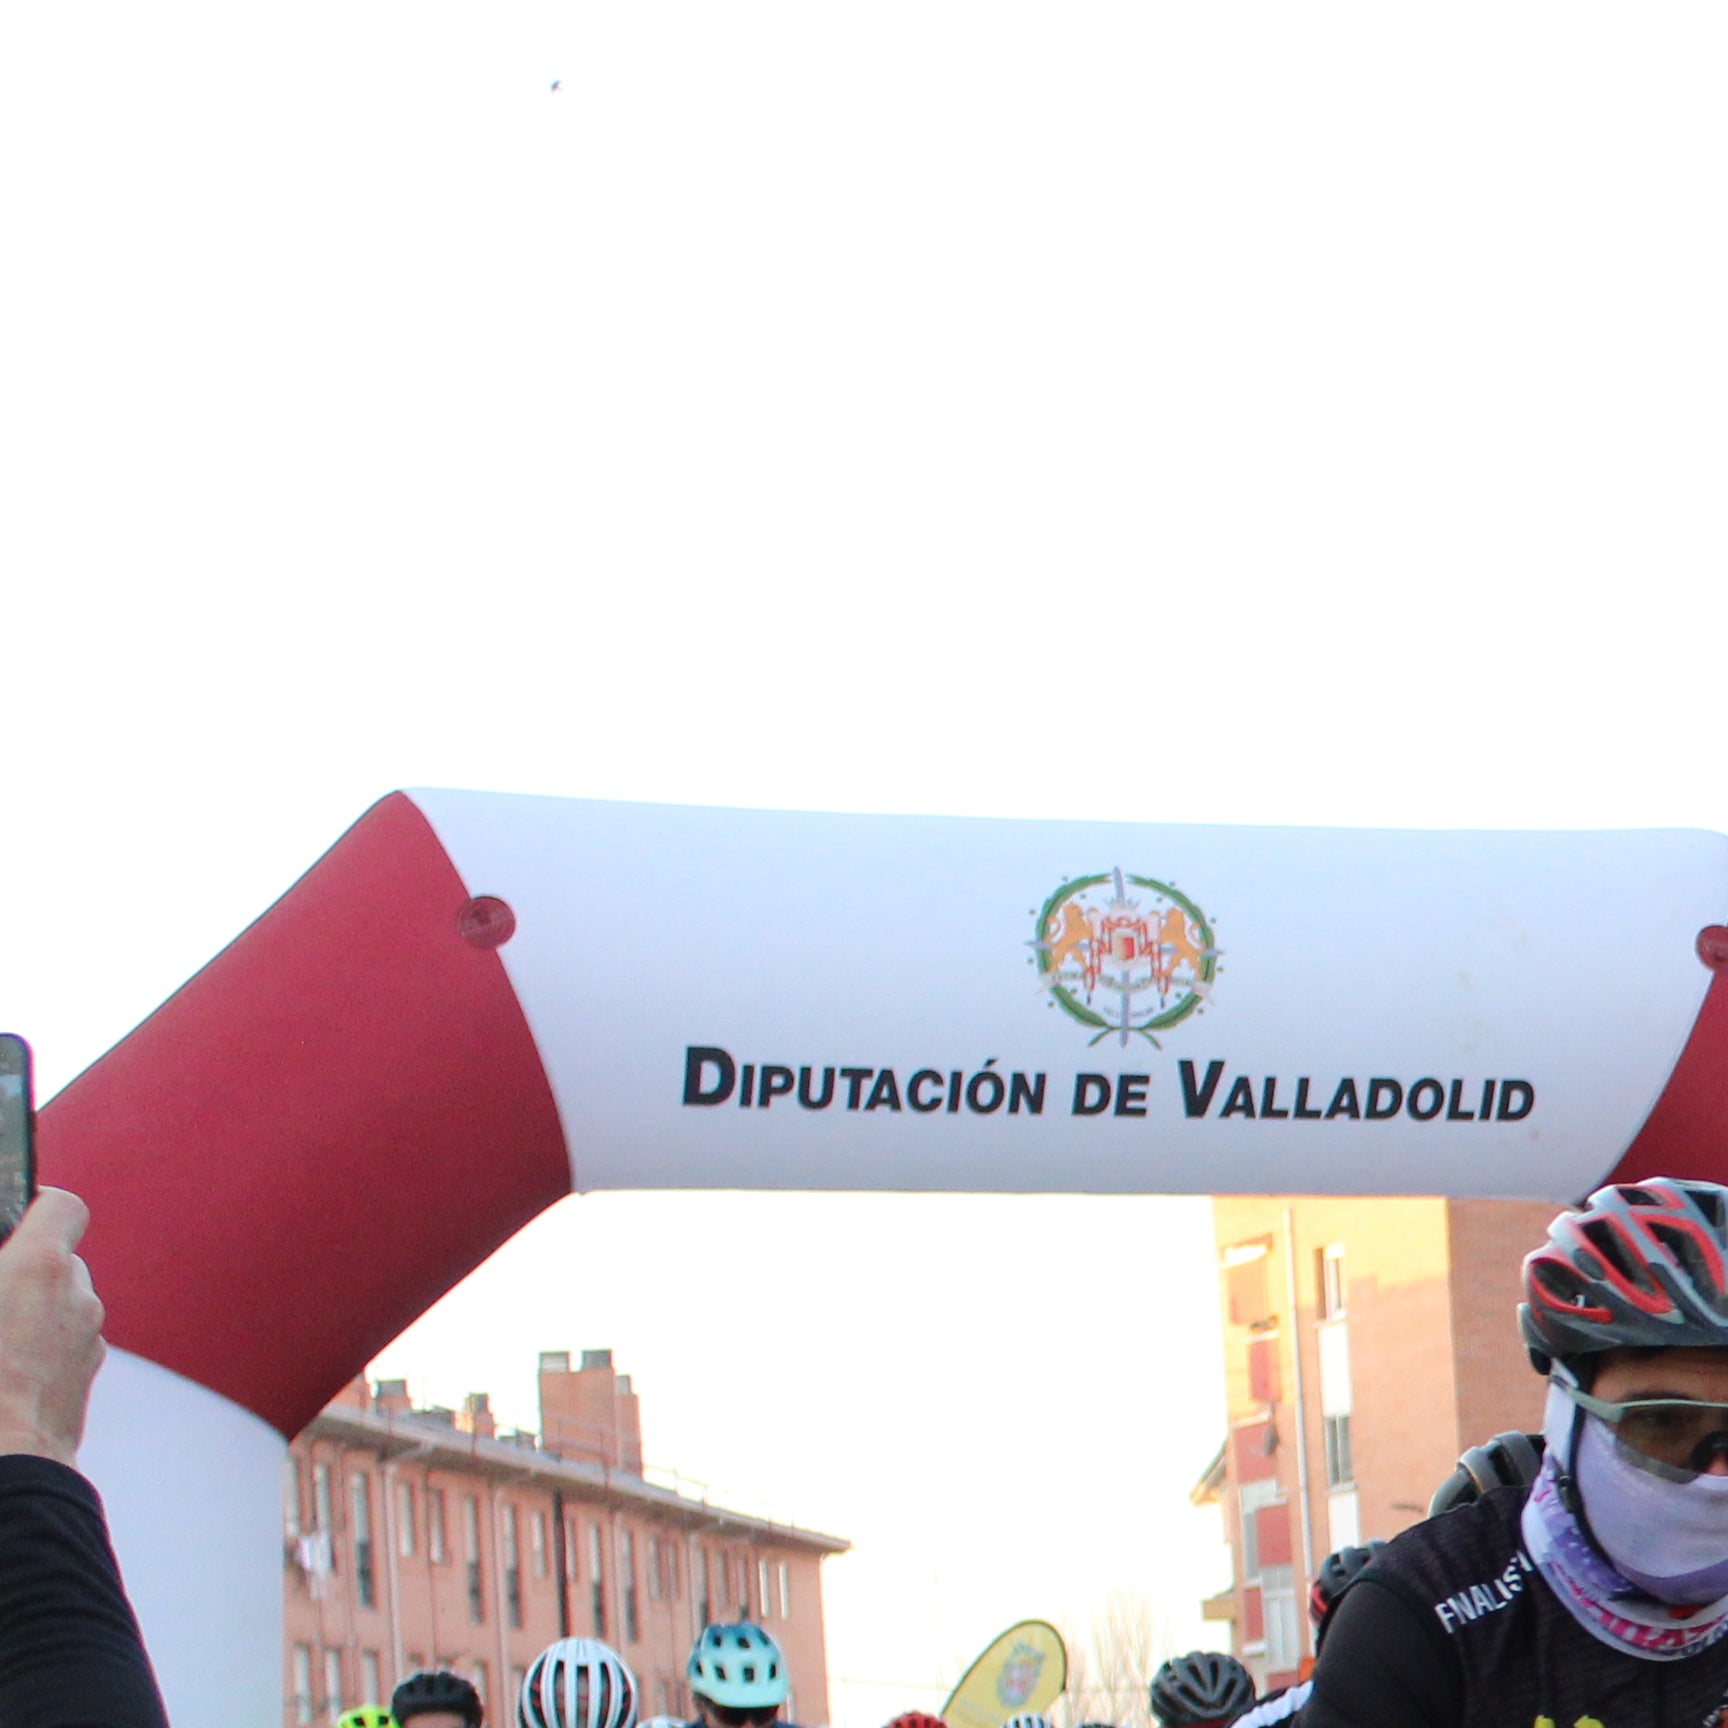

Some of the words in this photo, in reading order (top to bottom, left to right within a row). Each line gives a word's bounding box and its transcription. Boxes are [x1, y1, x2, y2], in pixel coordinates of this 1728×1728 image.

[681, 1044, 1047, 1117] DIPUTACIÓN
[1071, 1070, 1151, 1119] DE
[1178, 1058, 1537, 1124] VALLADOLID
